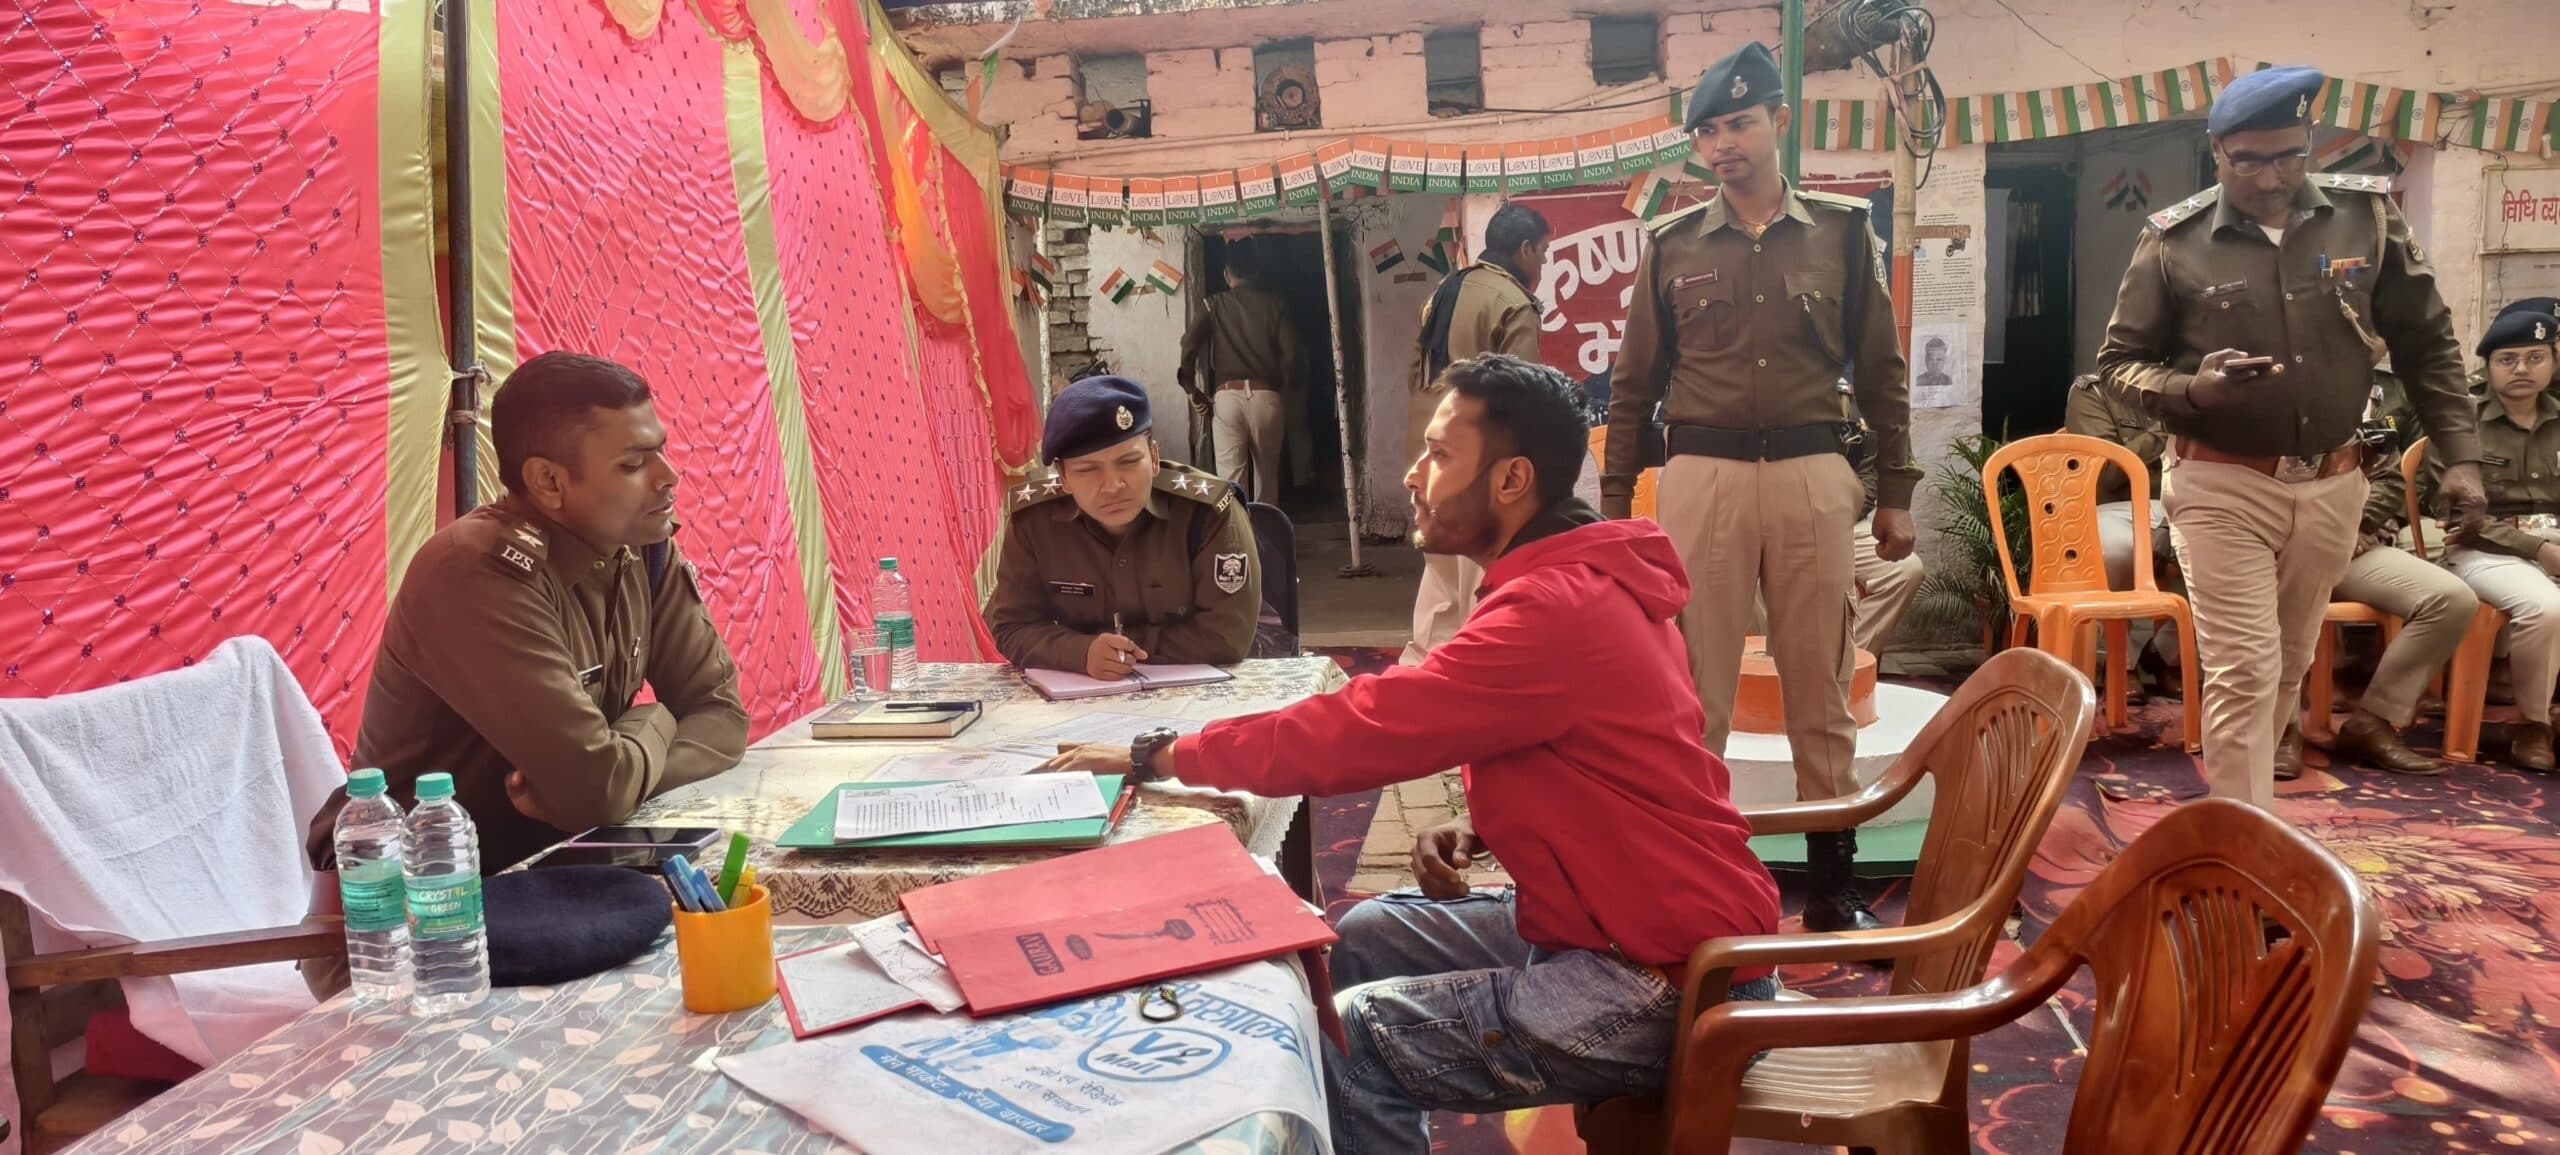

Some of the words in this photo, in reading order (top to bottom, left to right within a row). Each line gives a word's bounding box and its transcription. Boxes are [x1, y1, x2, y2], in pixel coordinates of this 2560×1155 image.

[1660, 144, 1690, 160] INDIA
[1622, 156, 1652, 170] INDIA
[1351, 169, 1379, 182] INDIA
[1544, 172, 1573, 184] INDIA
[1584, 166, 1612, 178] INDIA
[1392, 176, 1420, 186] INDIA
[1428, 178, 1457, 188] INDIA
[1469, 179, 1498, 188] INDIA
[1508, 176, 1538, 187] INDIA
[1288, 186, 1317, 200] INDIA
[1012, 200, 1040, 212] INDIA
[1246, 198, 1275, 210] INDIA
[2502, 189, 2537, 222] विधि
[1054, 206, 1081, 218] INDIA
[1091, 210, 1119, 220] INDIA
[1168, 210, 1196, 220] INDIA
[1207, 206, 1236, 216] INDIA
[1132, 213, 1160, 222] INDIA
[1095, 1053, 1164, 1074] Mall
